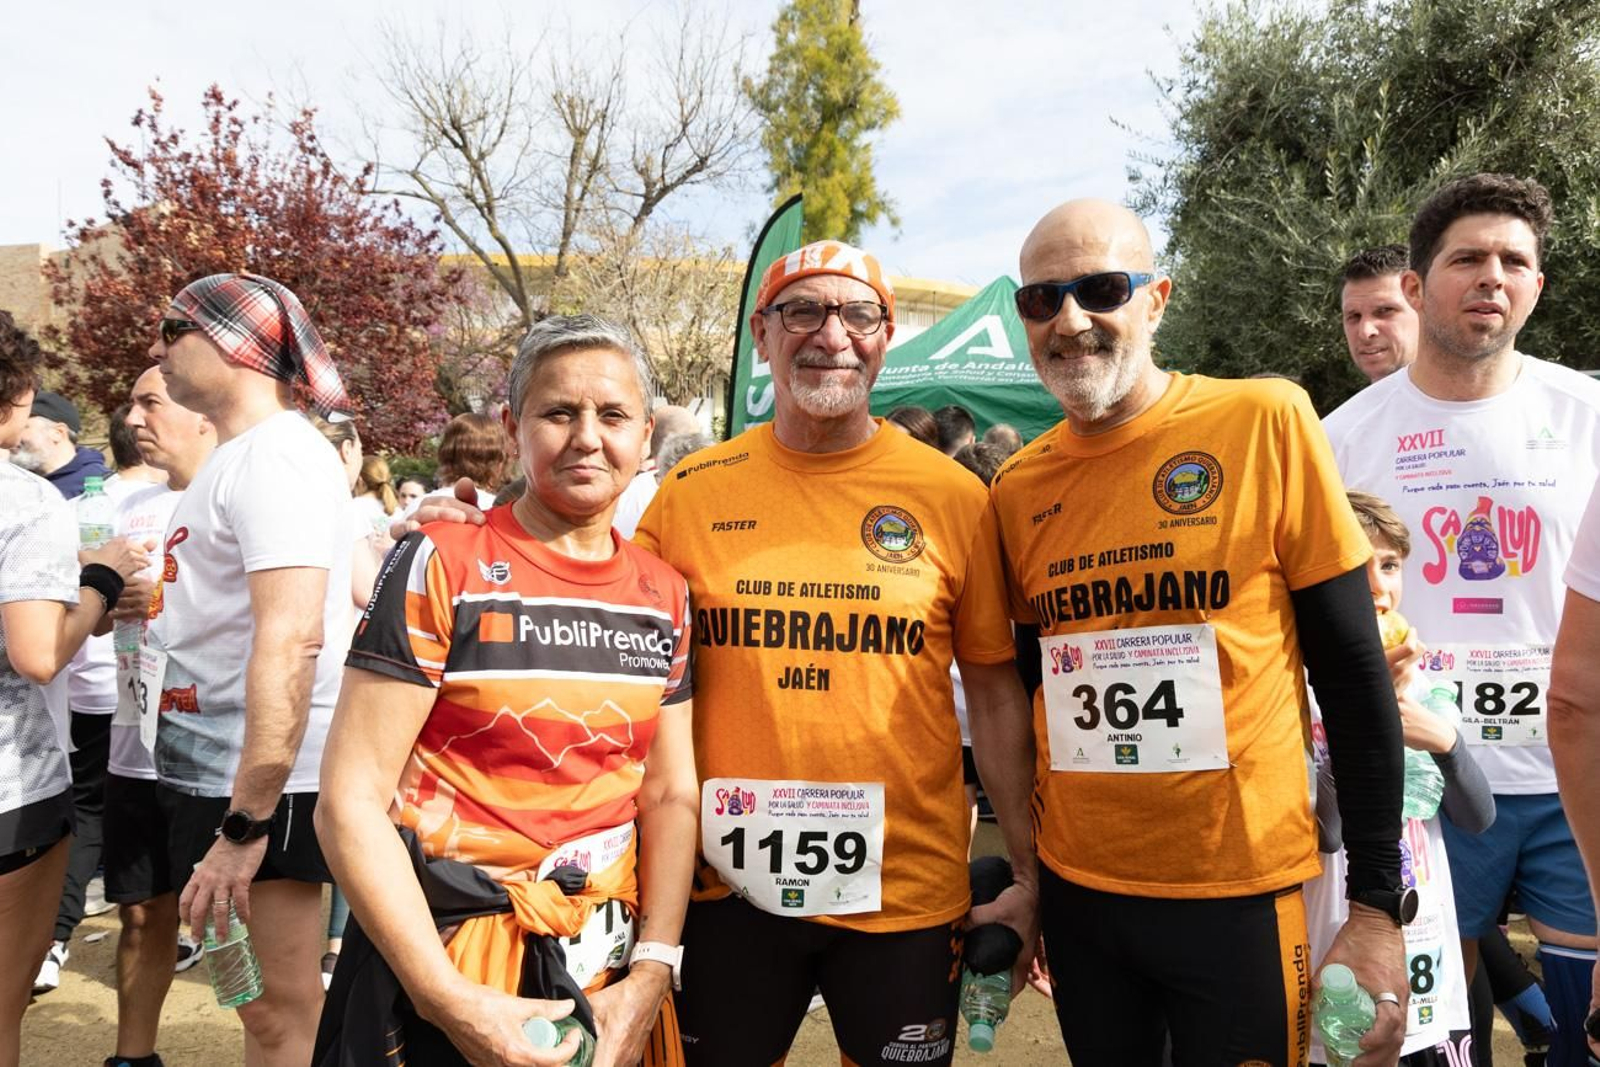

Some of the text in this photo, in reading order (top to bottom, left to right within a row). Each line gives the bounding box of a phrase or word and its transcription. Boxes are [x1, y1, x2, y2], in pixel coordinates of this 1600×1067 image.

[962, 361, 1034, 371] Andalu
[1397, 429, 1445, 454] XXVII
[1395, 448, 1467, 465] CARRERA POPULAR
[711, 520, 757, 532] FASTER
[1158, 516, 1218, 529] 30 ANIVERSARIO
[1048, 541, 1175, 578] CLUB DE ATLETISMO
[866, 563, 921, 578] 30 ANIVERSARIO
[736, 579, 881, 600] CLUB DE ATLETISMO
[519, 614, 672, 656] PubliPrenda
[698, 607, 925, 656] QUIEBRAJANO
[1094, 632, 1193, 651] XXVII CARRERA POPULAR
[1092, 653, 1101, 662] POR
[1109, 651, 1126, 660] SALUD
[1134, 648, 1164, 658] CAMINATA
[1164, 646, 1200, 657] INCLUSIVA
[1468, 650, 1492, 659] XXVII
[1493, 649, 1521, 658] CARRERA
[777, 662, 830, 691] JAÉN
[1072, 679, 1184, 731] 364
[1107, 733, 1143, 742] ANTINIO
[772, 787, 865, 800] XXVII CARRERA POPULAR
[768, 801, 779, 809] POR
[780, 801, 786, 809] LA
[787, 801, 804, 809] SALUD
[811, 801, 840, 809] CAMINATA
[841, 801, 870, 810] INCLUSIVA
[721, 827, 867, 875] 1159
[775, 877, 810, 887] RAMON
[1293, 944, 1308, 1067] ubliPrenda
